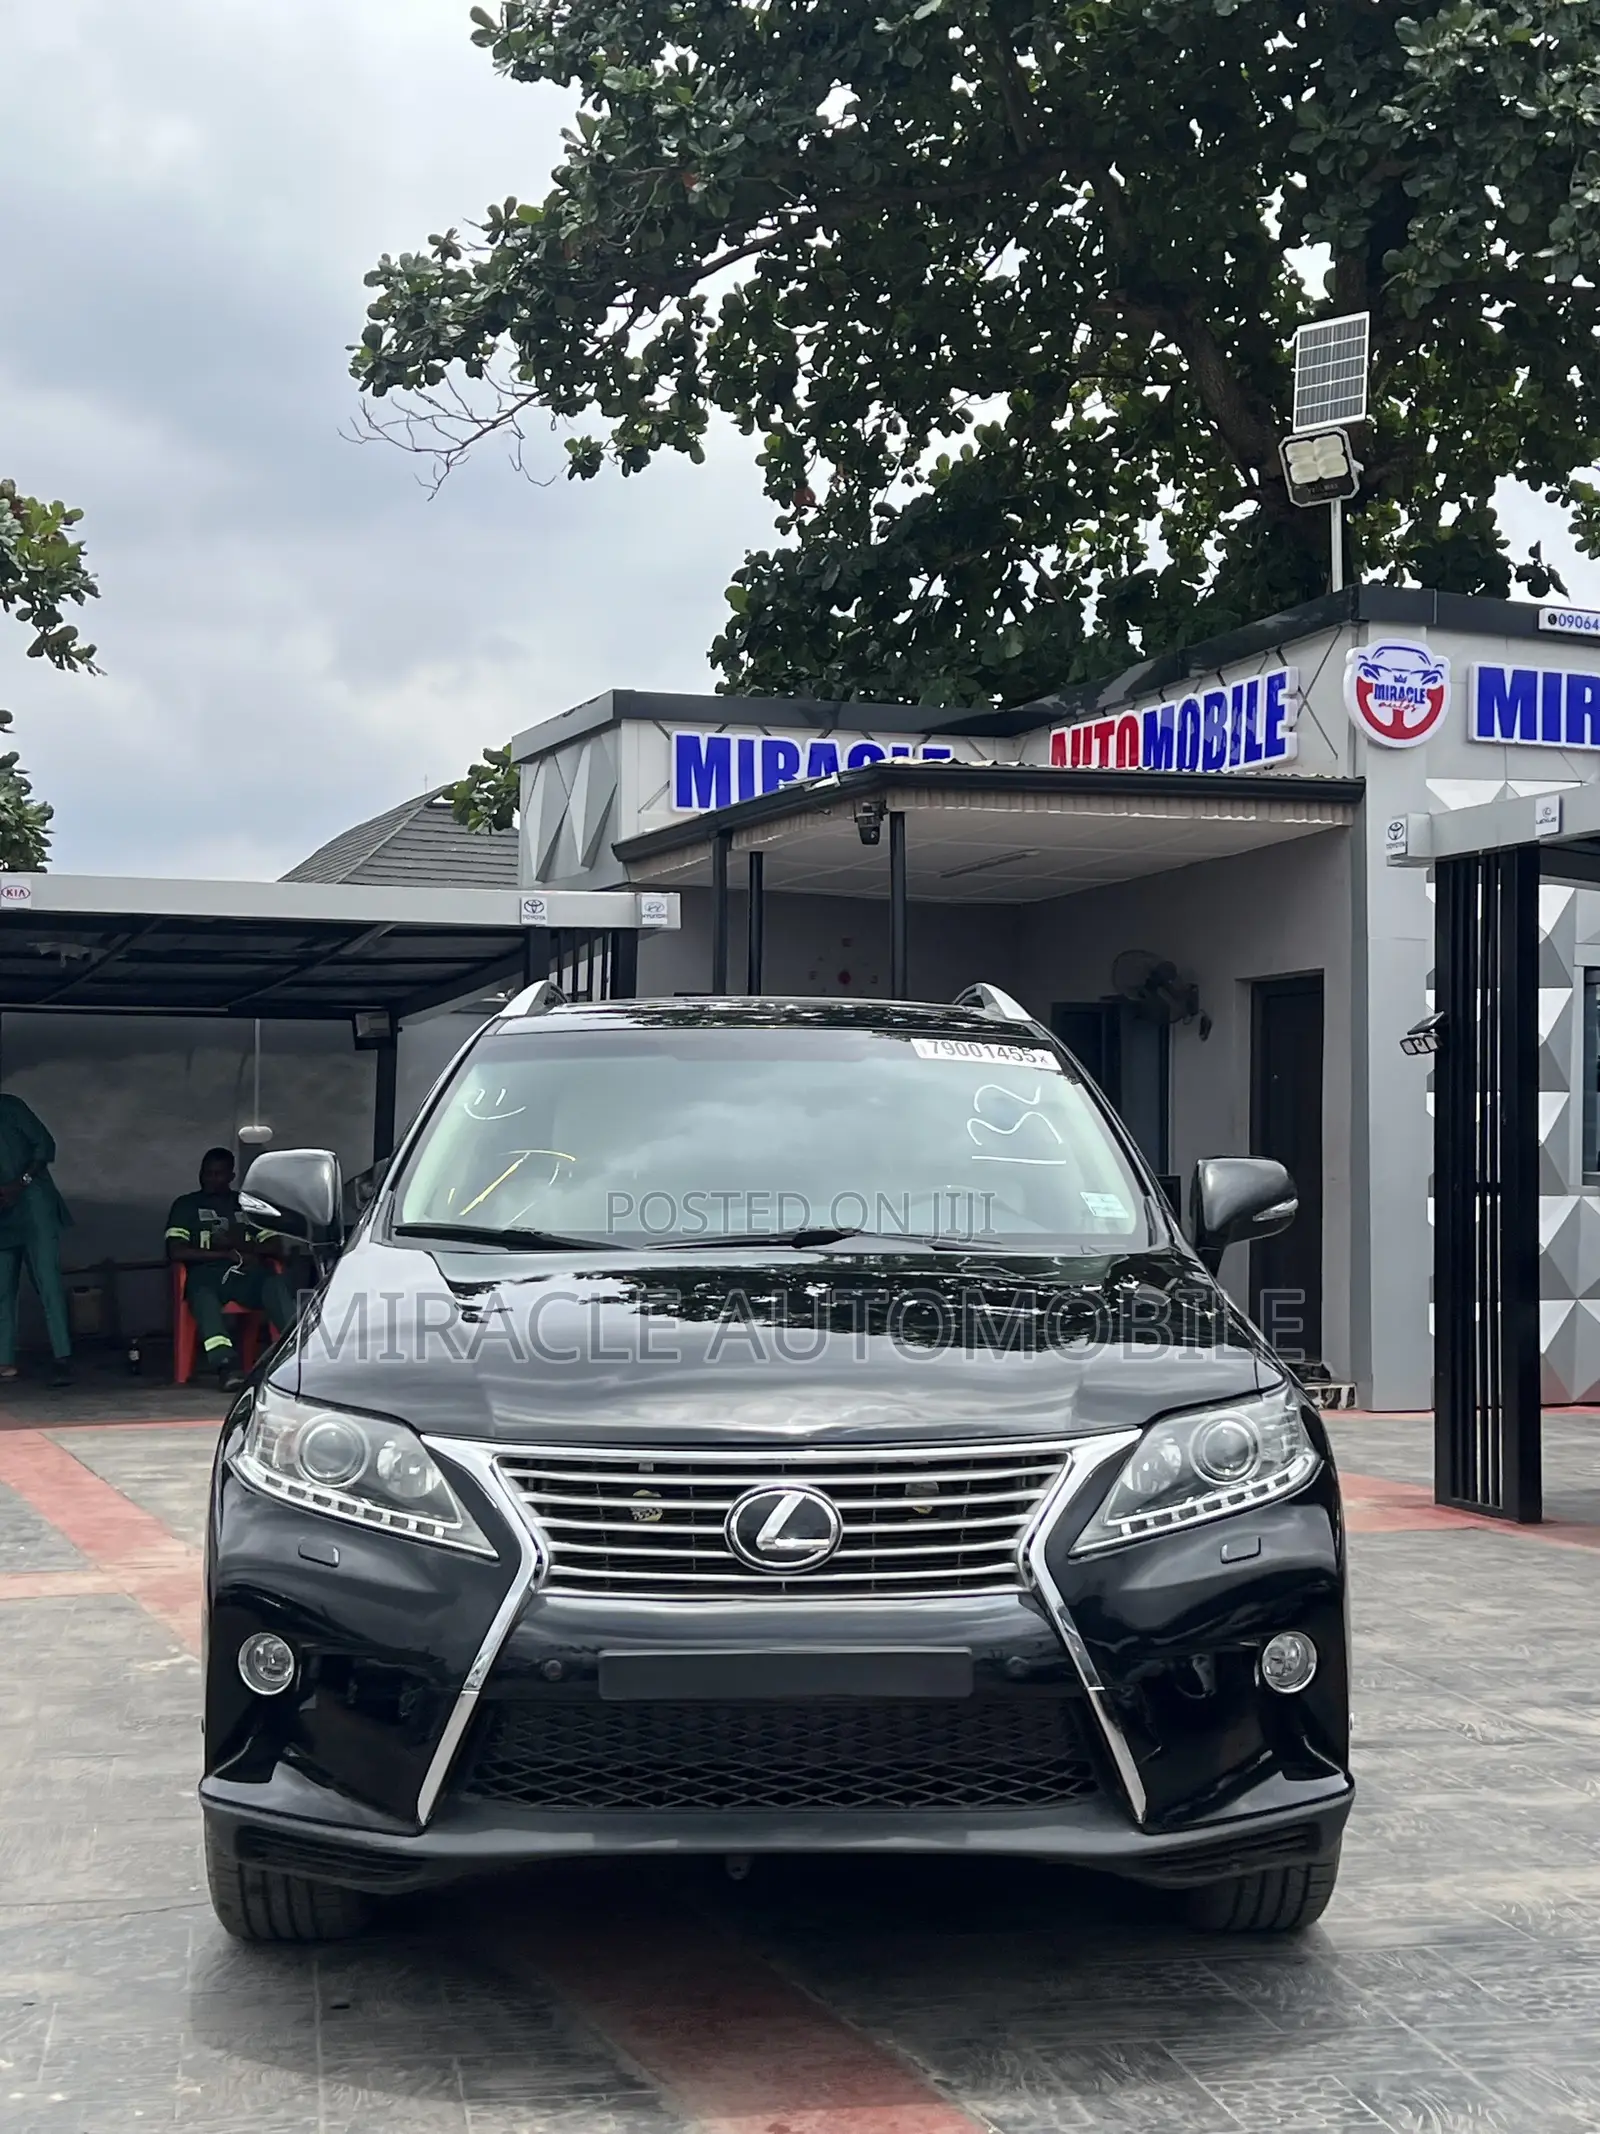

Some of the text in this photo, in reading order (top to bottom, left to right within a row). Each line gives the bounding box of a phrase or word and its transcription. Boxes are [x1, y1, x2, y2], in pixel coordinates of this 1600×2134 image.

[1374, 683, 1426, 704] MIRACLE
[1051, 671, 1286, 771] AUTOMOBILE
[6, 888, 26, 898] KIA
